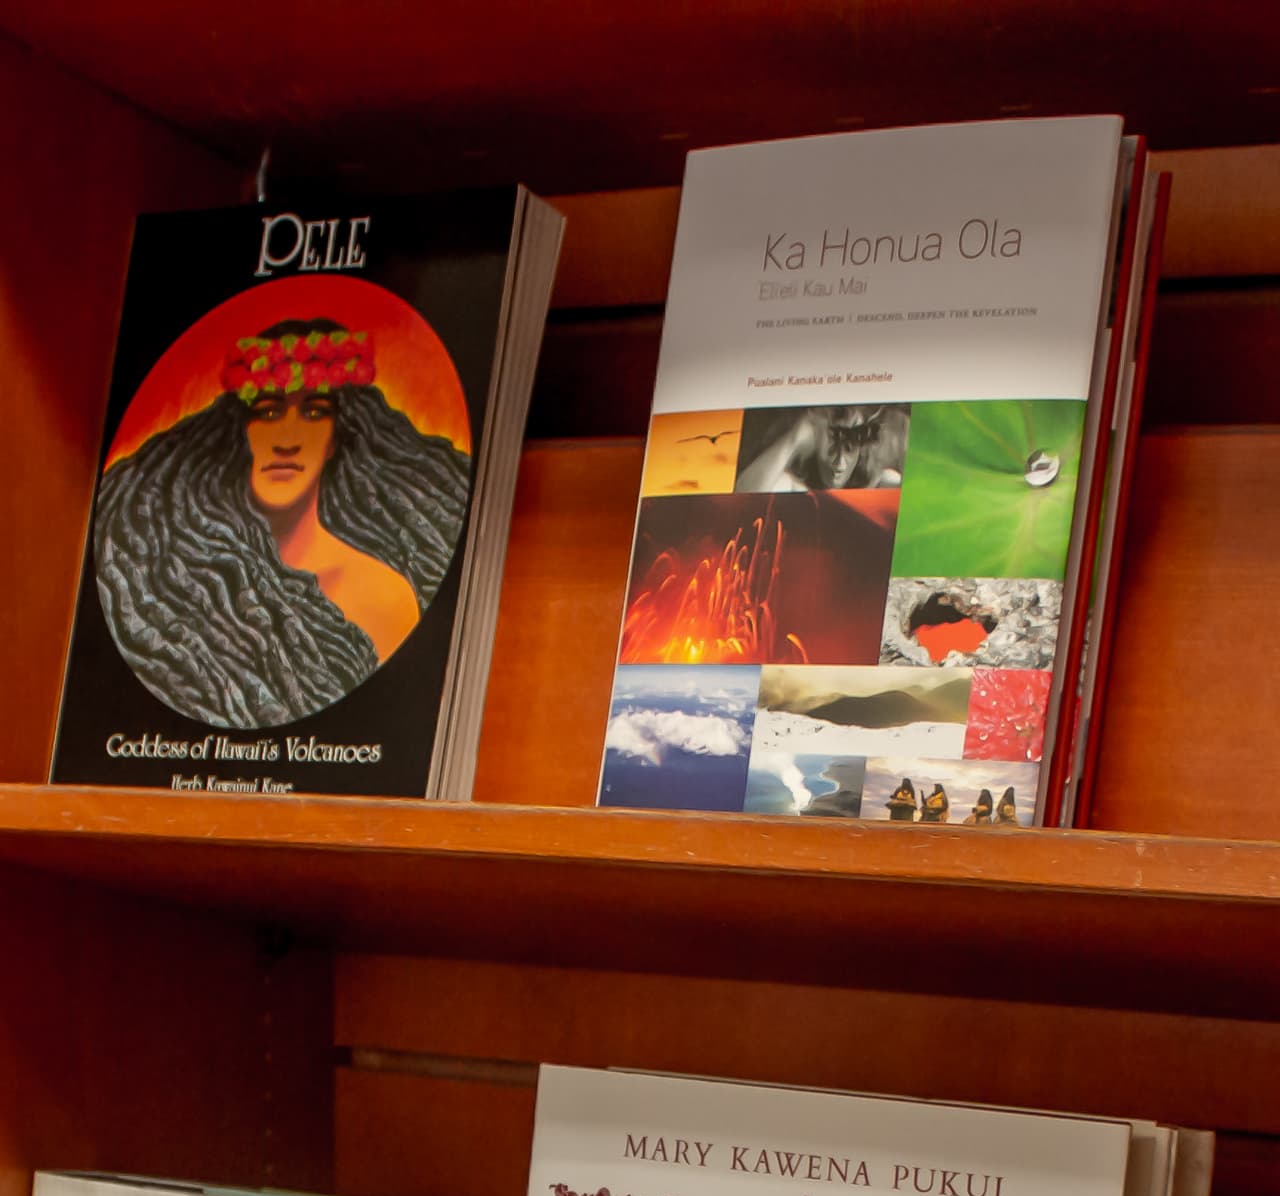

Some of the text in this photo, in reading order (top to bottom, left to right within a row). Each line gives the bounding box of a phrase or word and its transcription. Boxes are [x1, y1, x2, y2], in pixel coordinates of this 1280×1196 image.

[254, 212, 370, 277] PELE
[762, 218, 1023, 272] Ka Honua Ola
[839, 275, 868, 296] Mai
[972, 305, 1038, 318] REVELATION
[846, 371, 893, 384] Kanahele
[105, 733, 188, 760] Goddess
[190, 734, 214, 761] of
[285, 736, 382, 763] Volcanoes
[623, 1134, 714, 1168] MARY
[729, 1145, 872, 1187] KAWENA
